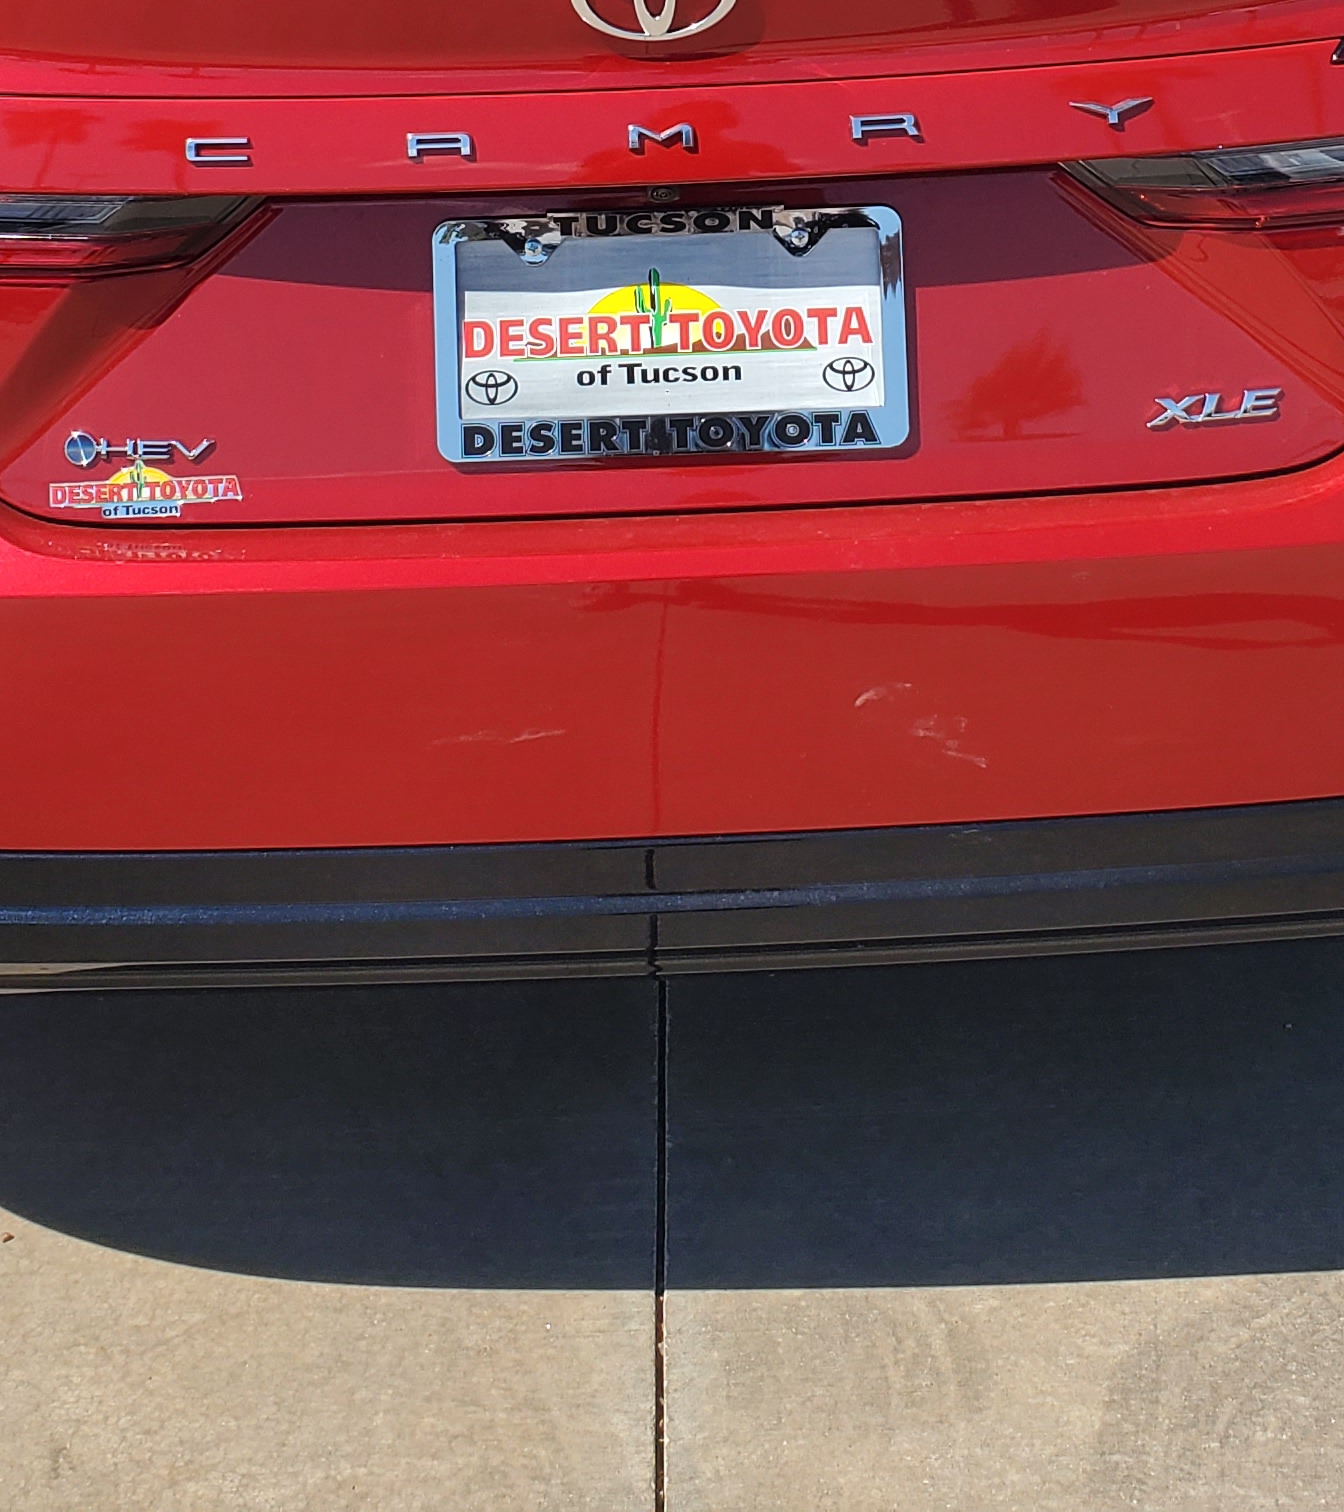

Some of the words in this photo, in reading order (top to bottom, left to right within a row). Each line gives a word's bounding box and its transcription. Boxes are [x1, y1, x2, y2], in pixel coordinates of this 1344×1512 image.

[553, 209, 774, 237] TUCSON
[463, 313, 653, 359] DESERT
[667, 306, 874, 350] TOYOTA
[576, 364, 611, 386] of
[618, 361, 742, 385] Tucson
[1146, 388, 1282, 423] XLE
[462, 419, 648, 458] DESERT
[669, 410, 881, 450] TOYOTA
[99, 437, 216, 460] HEV
[50, 483, 140, 506] DESERT
[149, 477, 240, 501] TOYOTA
[102, 505, 119, 517] of
[122, 504, 179, 516] Tucson
